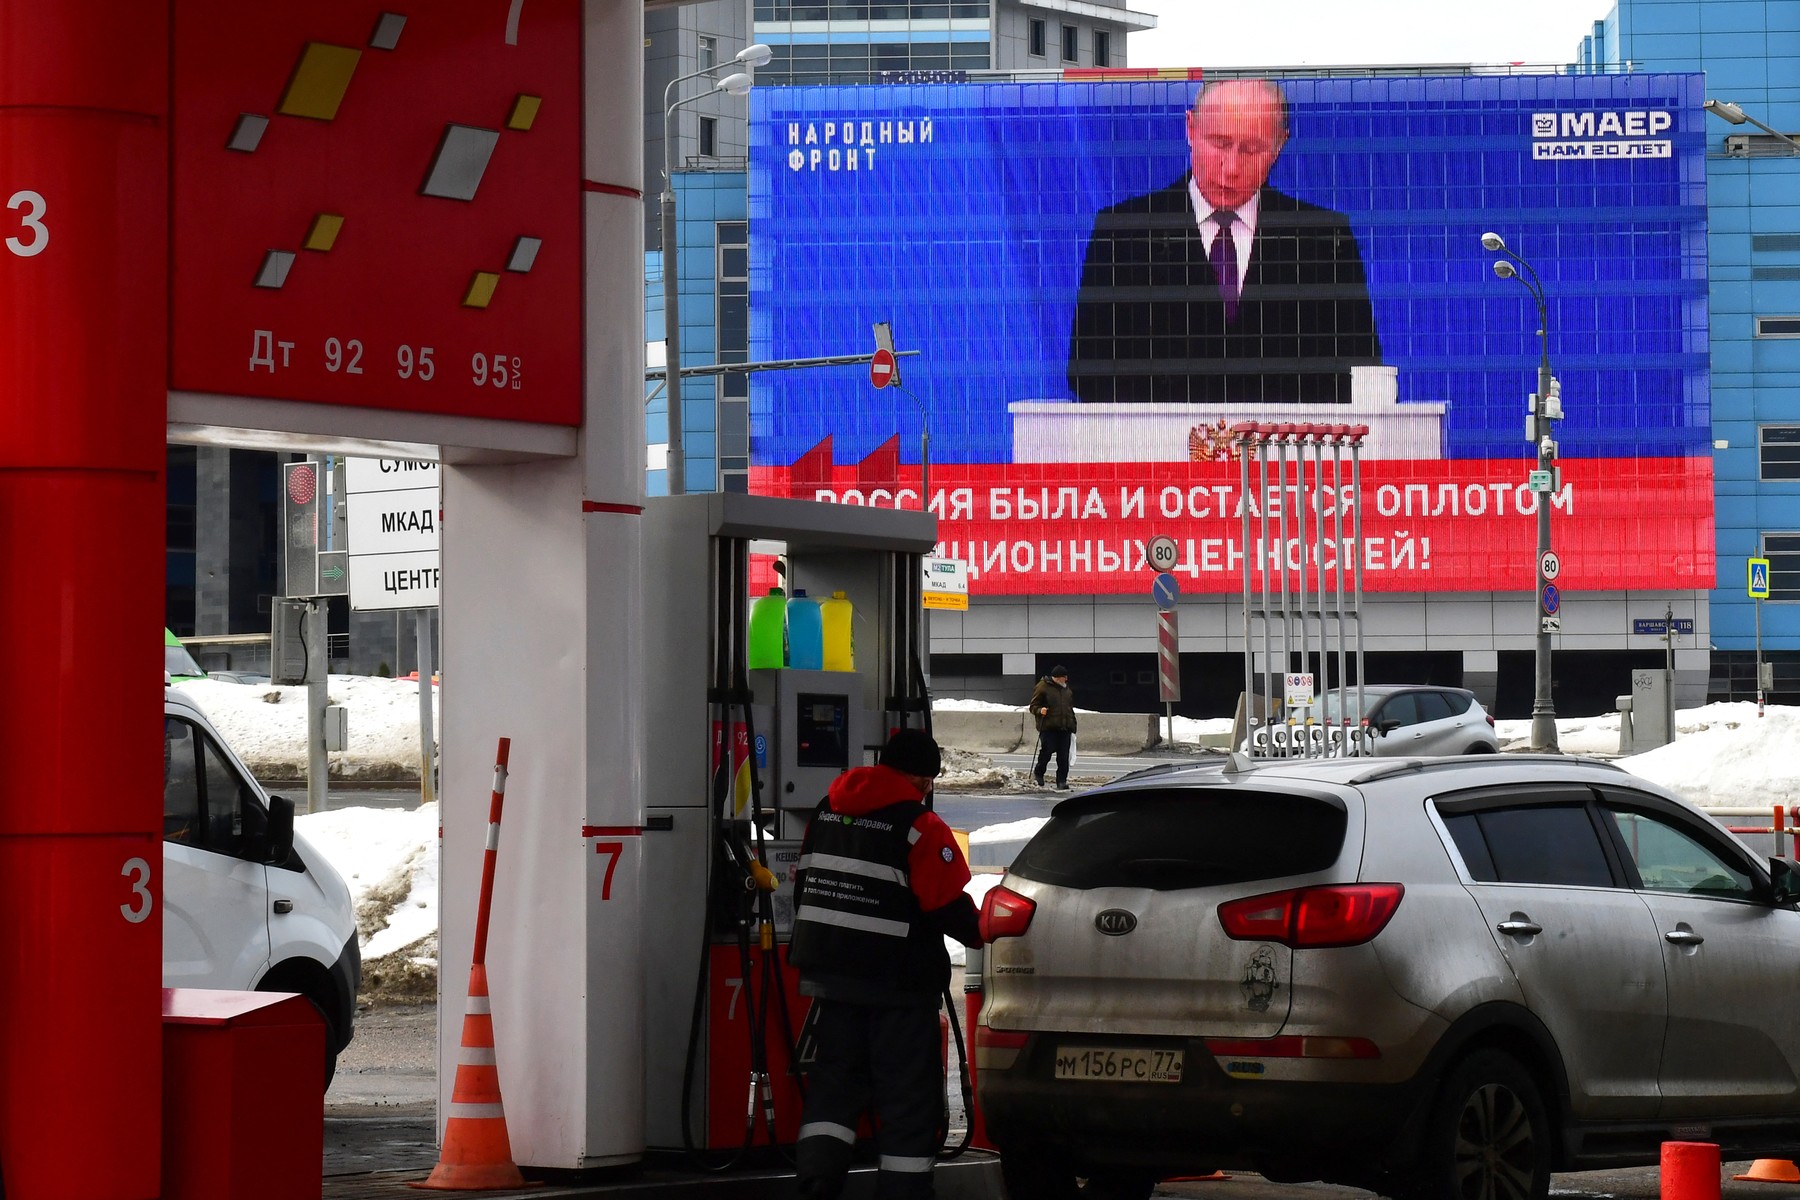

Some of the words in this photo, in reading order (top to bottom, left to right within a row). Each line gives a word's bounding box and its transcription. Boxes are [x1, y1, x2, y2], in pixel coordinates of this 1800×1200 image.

[789, 117, 932, 146] НАРОДНЫЙ
[1562, 111, 1672, 137] МАЕР
[789, 149, 875, 171] ФРОНТ
[1538, 145, 1585, 156] НАМ
[1592, 144, 1619, 155] 20
[1626, 143, 1666, 154] ЛЕТ
[5, 190, 49, 256] 3
[249, 329, 295, 373] Дт
[325, 337, 363, 374] 92
[397, 345, 435, 381] 95
[472, 352, 508, 388] 95
[512, 357, 521, 389] EVO
[990, 486, 1107, 520] БЫЛА
[1121, 486, 1144, 519] И
[1377, 483, 1573, 517] ОПЛОТОМ
[381, 510, 433, 533] МКАД
[1156, 546, 1172, 561] 80
[1544, 559, 1556, 573] 80
[1680, 621, 1692, 629] 118
[737, 731, 749, 745] 92
[817, 810, 842, 823] Яндекс
[597, 842, 623, 900] 7
[120, 857, 152, 924] 3
[808, 888, 832, 897] топливо
[818, 878, 838, 887] можно
[839, 882, 864, 891] платить
[1101, 915, 1132, 930] KIA
[725, 978, 743, 1020] 7
[1154, 1051, 1176, 1072] 77
[1151, 1071, 1168, 1080] RUS
